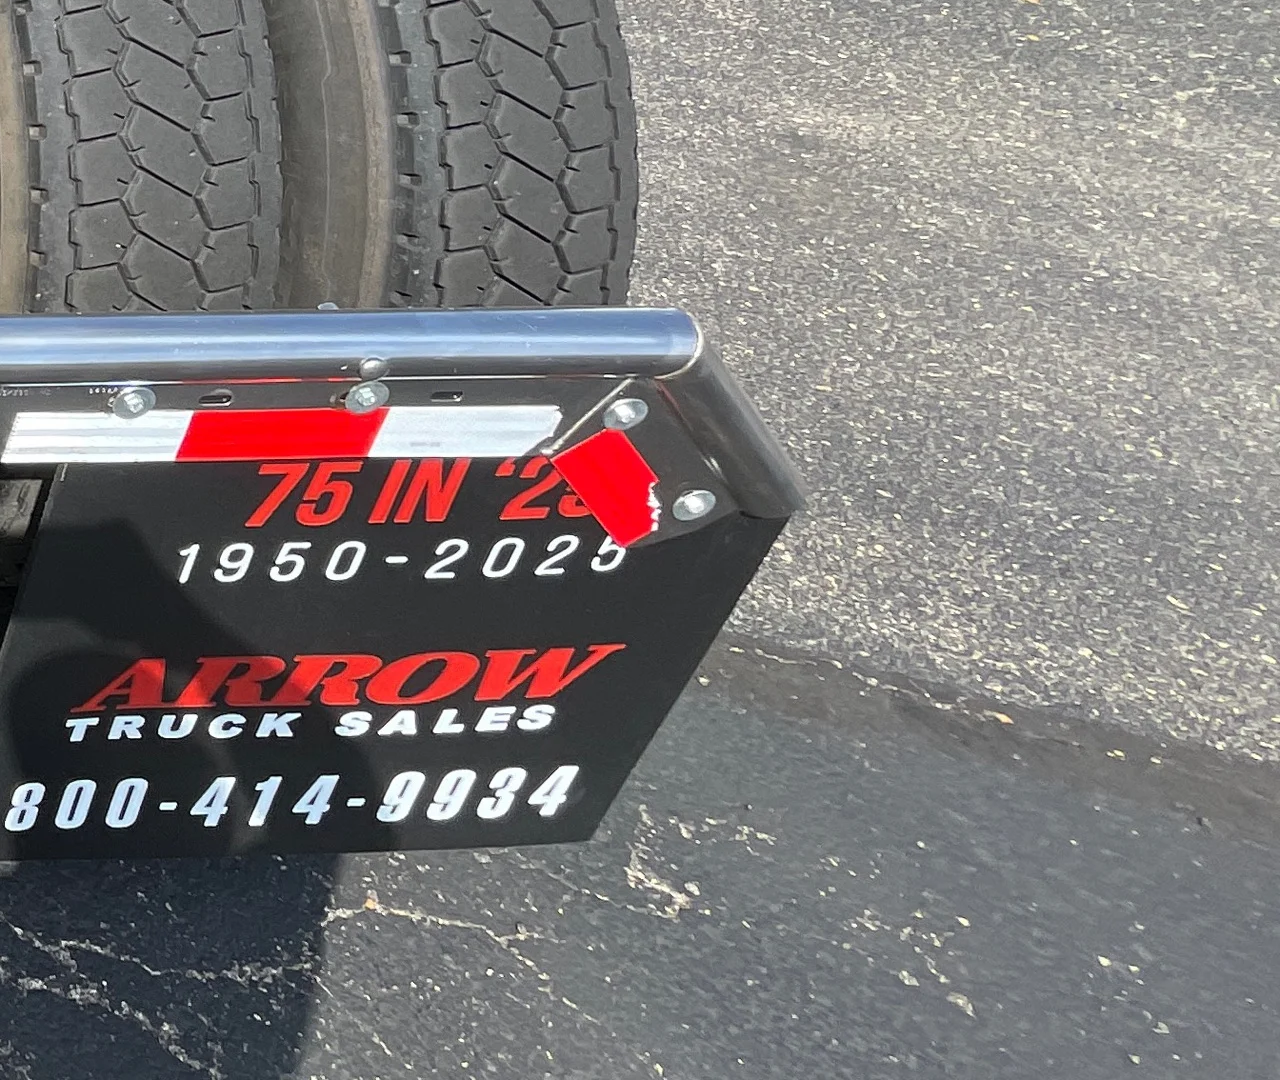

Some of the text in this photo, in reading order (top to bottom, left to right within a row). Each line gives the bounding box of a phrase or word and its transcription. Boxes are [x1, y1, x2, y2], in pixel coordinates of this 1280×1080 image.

[244, 459, 362, 528] 75
[368, 459, 469, 524] IN
[177, 534, 627, 584] 1950-2025
[71, 643, 627, 713] ARROW
[64, 703, 557, 744] TRUCK SALES
[2, 764, 580, 833] 800-414-9934
